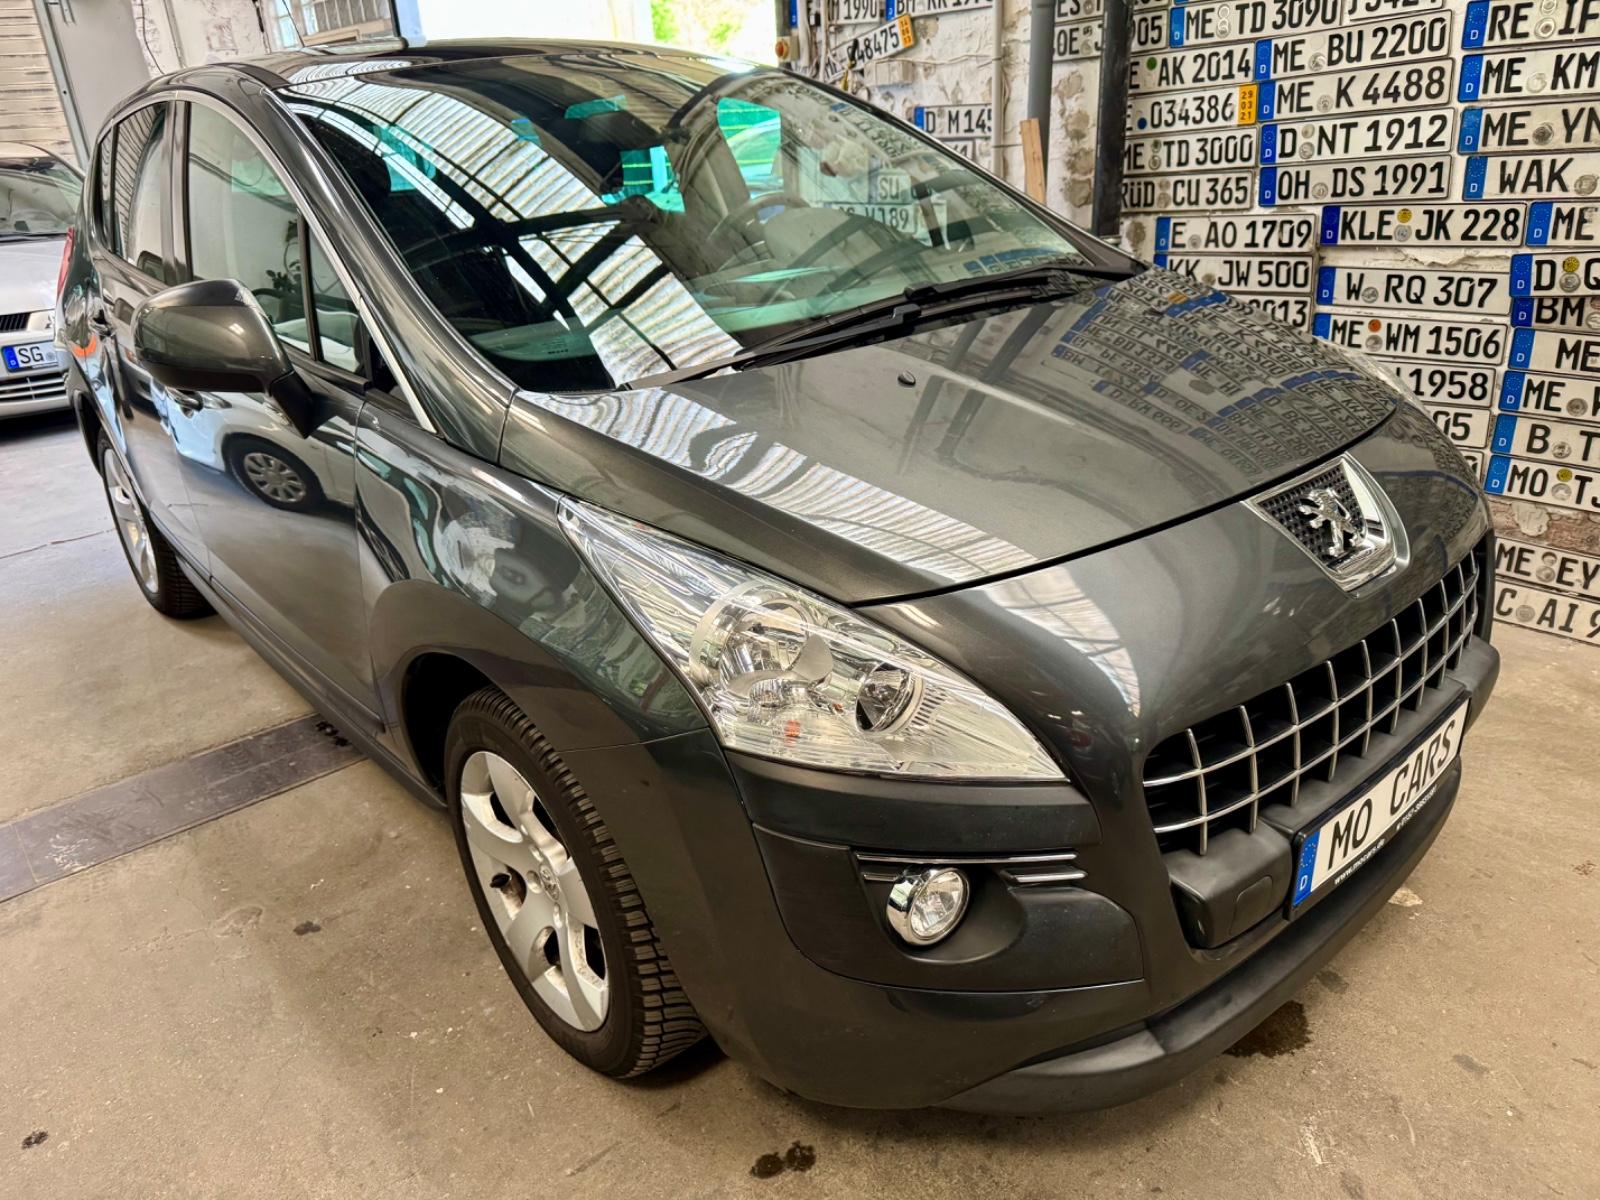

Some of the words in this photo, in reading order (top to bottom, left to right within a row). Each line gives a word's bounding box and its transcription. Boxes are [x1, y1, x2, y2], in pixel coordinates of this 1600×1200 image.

[1132, 15, 1162, 46] 05
[1186, 8, 1215, 40] ME
[1236, 2, 1265, 34] TD
[1272, 0, 1338, 30] 3090
[1470, 30, 1478, 40] D
[1488, 2, 1534, 41] RE
[1273, 39, 1305, 74] ME
[1327, 30, 1363, 67] BU
[1371, 18, 1446, 61] 2200
[1158, 56, 1185, 87] AK
[1192, 48, 1251, 83] 2014
[1465, 83, 1473, 93] D
[1482, 57, 1526, 95] ME
[1550, 51, 1600, 91] KM
[1277, 81, 1314, 114] ME
[1335, 76, 1356, 108] K
[1362, 66, 1446, 104] 4488
[926, 111, 936, 134] D
[948, 110, 959, 133] M
[1151, 93, 1233, 129] 034386
[1279, 128, 1297, 158] D
[1317, 121, 1358, 156] NT
[1364, 114, 1447, 152] 1912
[1481, 111, 1531, 148] ME
[1163, 140, 1189, 168] TD
[1195, 134, 1253, 165] 3000
[879, 178, 899, 199] SU
[1172, 179, 1200, 206] CU
[1205, 176, 1248, 205] 365
[1278, 170, 1310, 200] OH
[1331, 167, 1365, 198] DS
[1373, 162, 1444, 196] 1991
[1499, 158, 1574, 194] WAK
[1171, 222, 1187, 248] E
[1204, 221, 1237, 248] AO
[1244, 220, 1312, 248] 1709
[1341, 210, 1395, 241] KLE
[1415, 209, 1454, 241] JK
[1461, 208, 1521, 241] 228
[1534, 228, 1542, 238] D
[1551, 207, 1598, 240] ME
[1218, 261, 1251, 287] JW
[1258, 261, 1310, 288] 500
[1347, 273, 1364, 300] W
[1384, 274, 1426, 304] RQ
[1433, 276, 1498, 308] 307
[1517, 280, 1525, 289] D
[1534, 260, 1556, 290] D
[1535, 298, 1585, 326] BM
[18, 346, 44, 364] SG
[1332, 320, 1364, 348] ME
[1386, 323, 1421, 354] WM
[1426, 326, 1500, 358] 1506
[1517, 353, 1525, 361] D
[1555, 338, 1600, 372] ME
[1409, 368, 1488, 401] 1958
[1507, 395, 1515, 404] D
[1522, 378, 1566, 412] ME
[1499, 438, 1506, 446] D
[1526, 423, 1551, 454] B
[1491, 479, 1500, 488] D
[1507, 464, 1549, 497] MO
[1496, 543, 1535, 576] ME
[1556, 557, 1600, 590] EY
[1495, 587, 1518, 617] C
[1536, 599, 1579, 633] AI
[1300, 875, 1308, 890] D
[1328, 799, 1372, 870] MO
[1390, 720, 1455, 816] CARS
